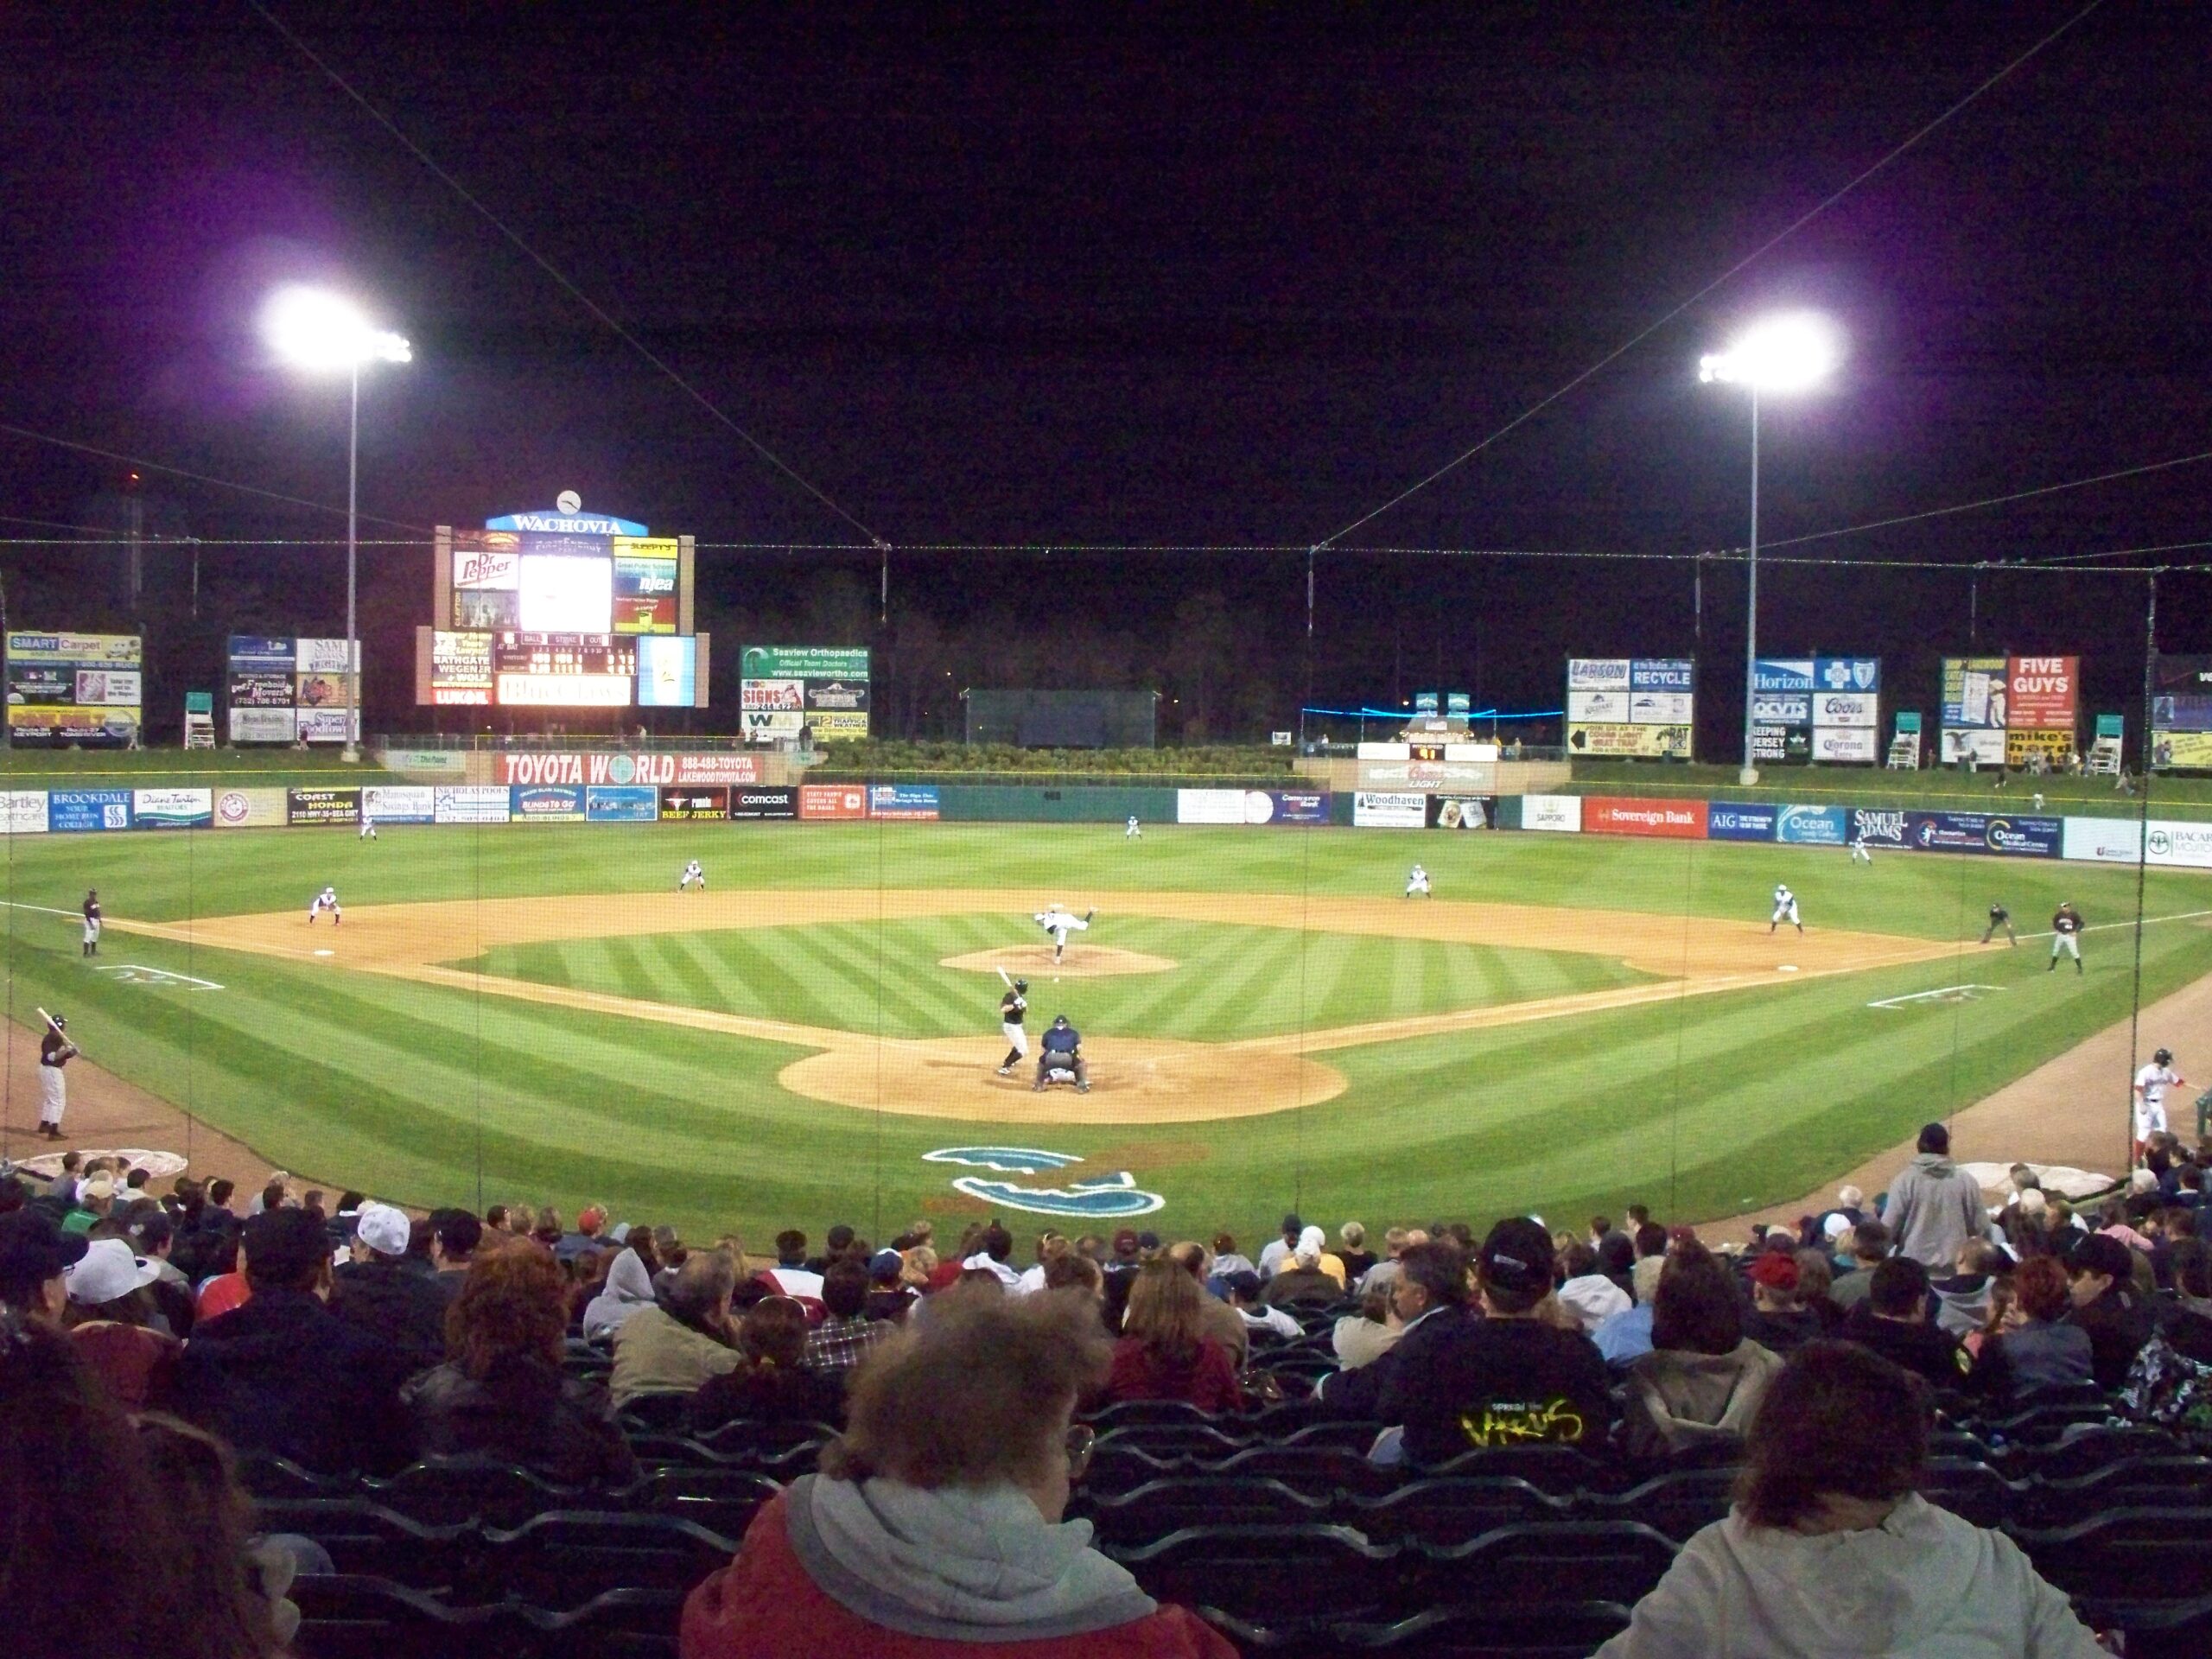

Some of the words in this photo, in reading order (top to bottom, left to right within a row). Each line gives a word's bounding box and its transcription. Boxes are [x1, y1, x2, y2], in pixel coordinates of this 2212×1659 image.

[512, 515, 624, 534] WACHOVIA
[478, 554, 495, 567] Dr
[463, 560, 511, 580] Pepper
[639, 575, 674, 591] njea
[13, 638, 56, 648] SMART
[61, 639, 101, 651] Carpet
[433, 656, 489, 664] BATHGATE
[772, 649, 808, 658] Seaview
[810, 649, 868, 658] Orthopaedics
[1573, 661, 1627, 678] LARSON
[2019, 658, 2063, 673] FIVE
[1634, 672, 1690, 684] RECYCLE
[1754, 673, 1814, 689] Horizon
[2013, 677, 2069, 693] GUYS
[252, 688, 284, 697] Movers
[743, 690, 781, 703] SIGNS
[1825, 698, 1863, 714] Coors
[315, 711, 346, 725] Super
[2009, 731, 2072, 742] mike's
[1824, 740, 1863, 751] Corona
[505, 754, 583, 784] TOYOTA
[682, 757, 753, 769] 888-488-TOYOTA
[678, 772, 756, 783] LAKEWOODTOYOTA.COM
[1409, 780, 1443, 789] LIGHT
[54, 793, 130, 804] BROOKDALE
[143, 794, 169, 804] Diane
[741, 794, 788, 804] comcast
[1366, 794, 1424, 805] Woodhaven
[413, 801, 432, 810] Bank
[1536, 813, 1566, 822] SAPPORO
[1611, 809, 1663, 825] Sovereign
[1666, 810, 1694, 825] Bank
[1713, 814, 1736, 828] AIG
[1790, 817, 1834, 830] Ocean
[1854, 809, 1909, 828] SAMUEL
[1859, 824, 1903, 842] ADAMS
[1994, 830, 2025, 841] Ocean
